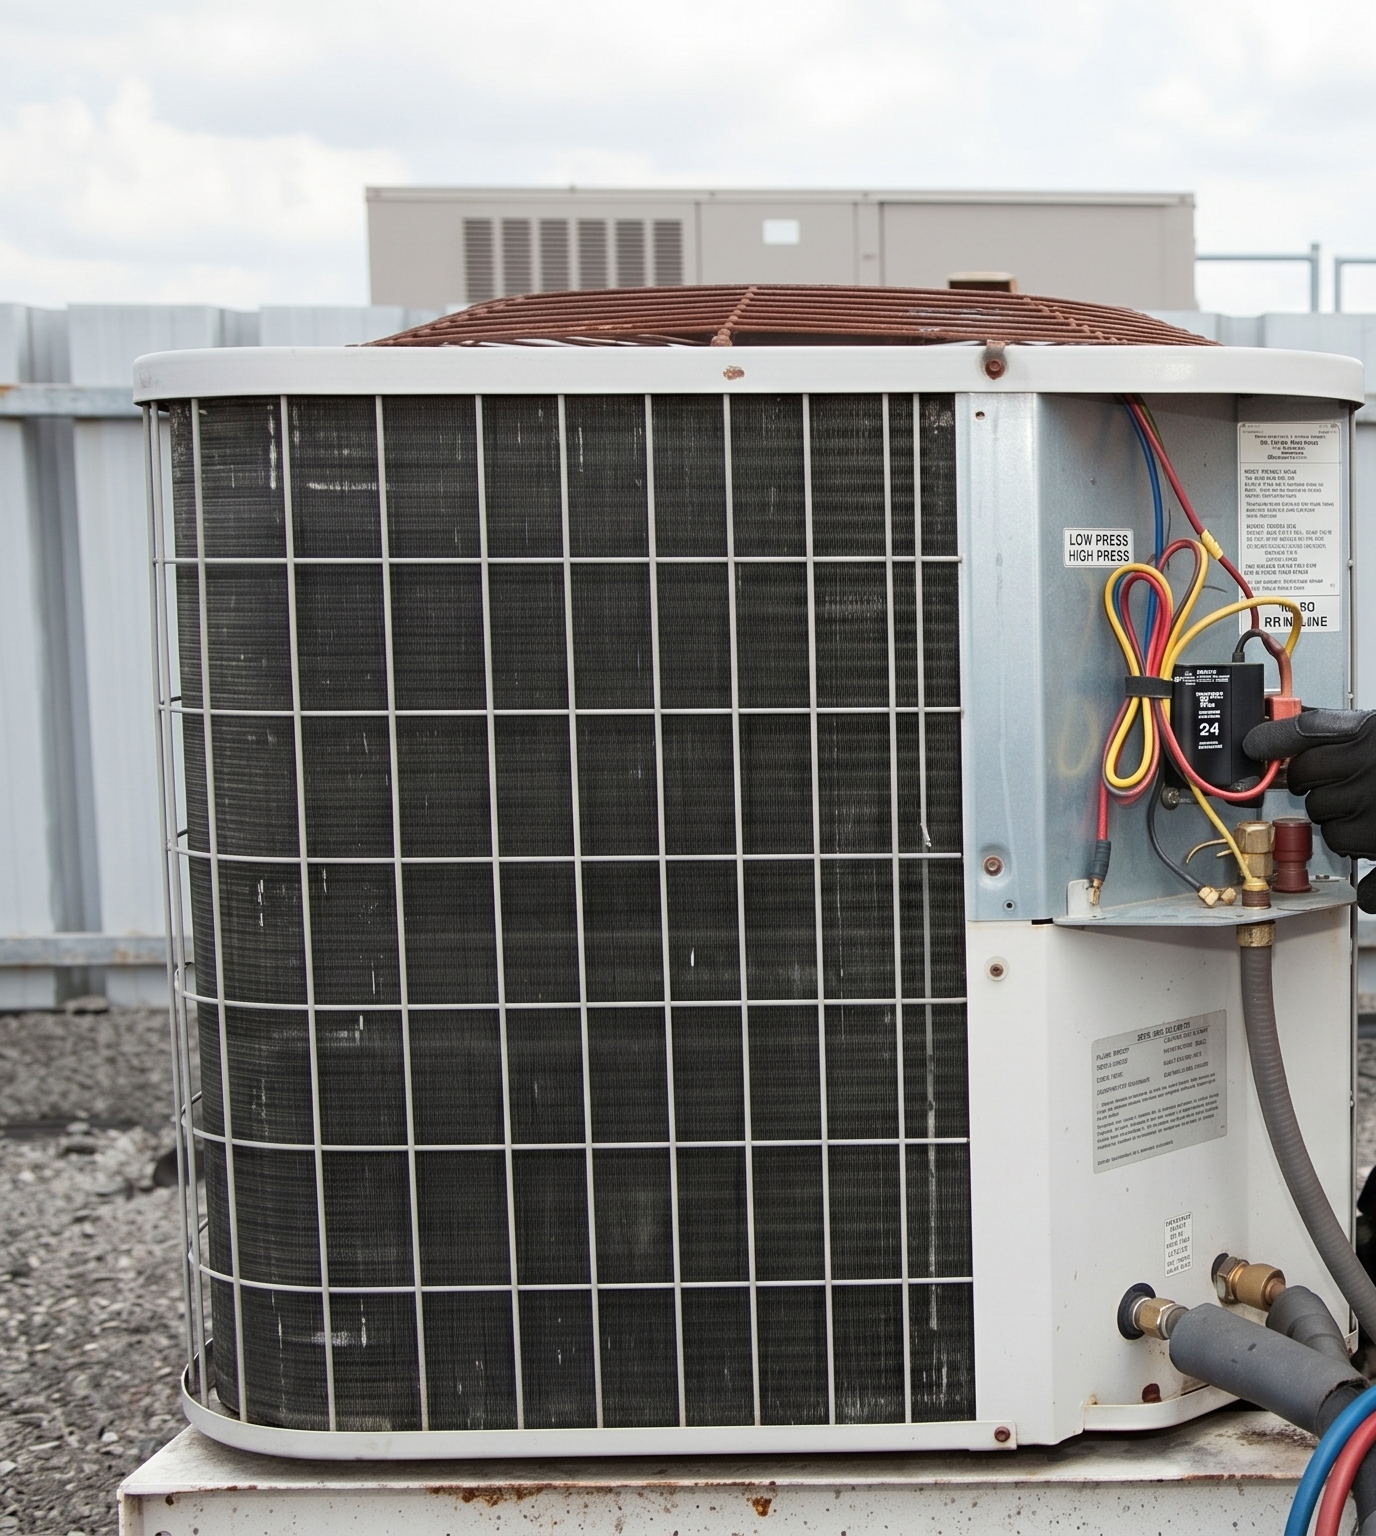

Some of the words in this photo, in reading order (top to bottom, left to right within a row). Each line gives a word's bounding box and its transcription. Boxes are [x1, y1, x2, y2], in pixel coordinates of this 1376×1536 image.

[1069, 533, 1093, 547] LOW
[1095, 533, 1129, 547] PRESS
[1068, 549, 1094, 562] HIGH
[1096, 549, 1130, 562] PRESS
[1199, 722, 1220, 736] 24
